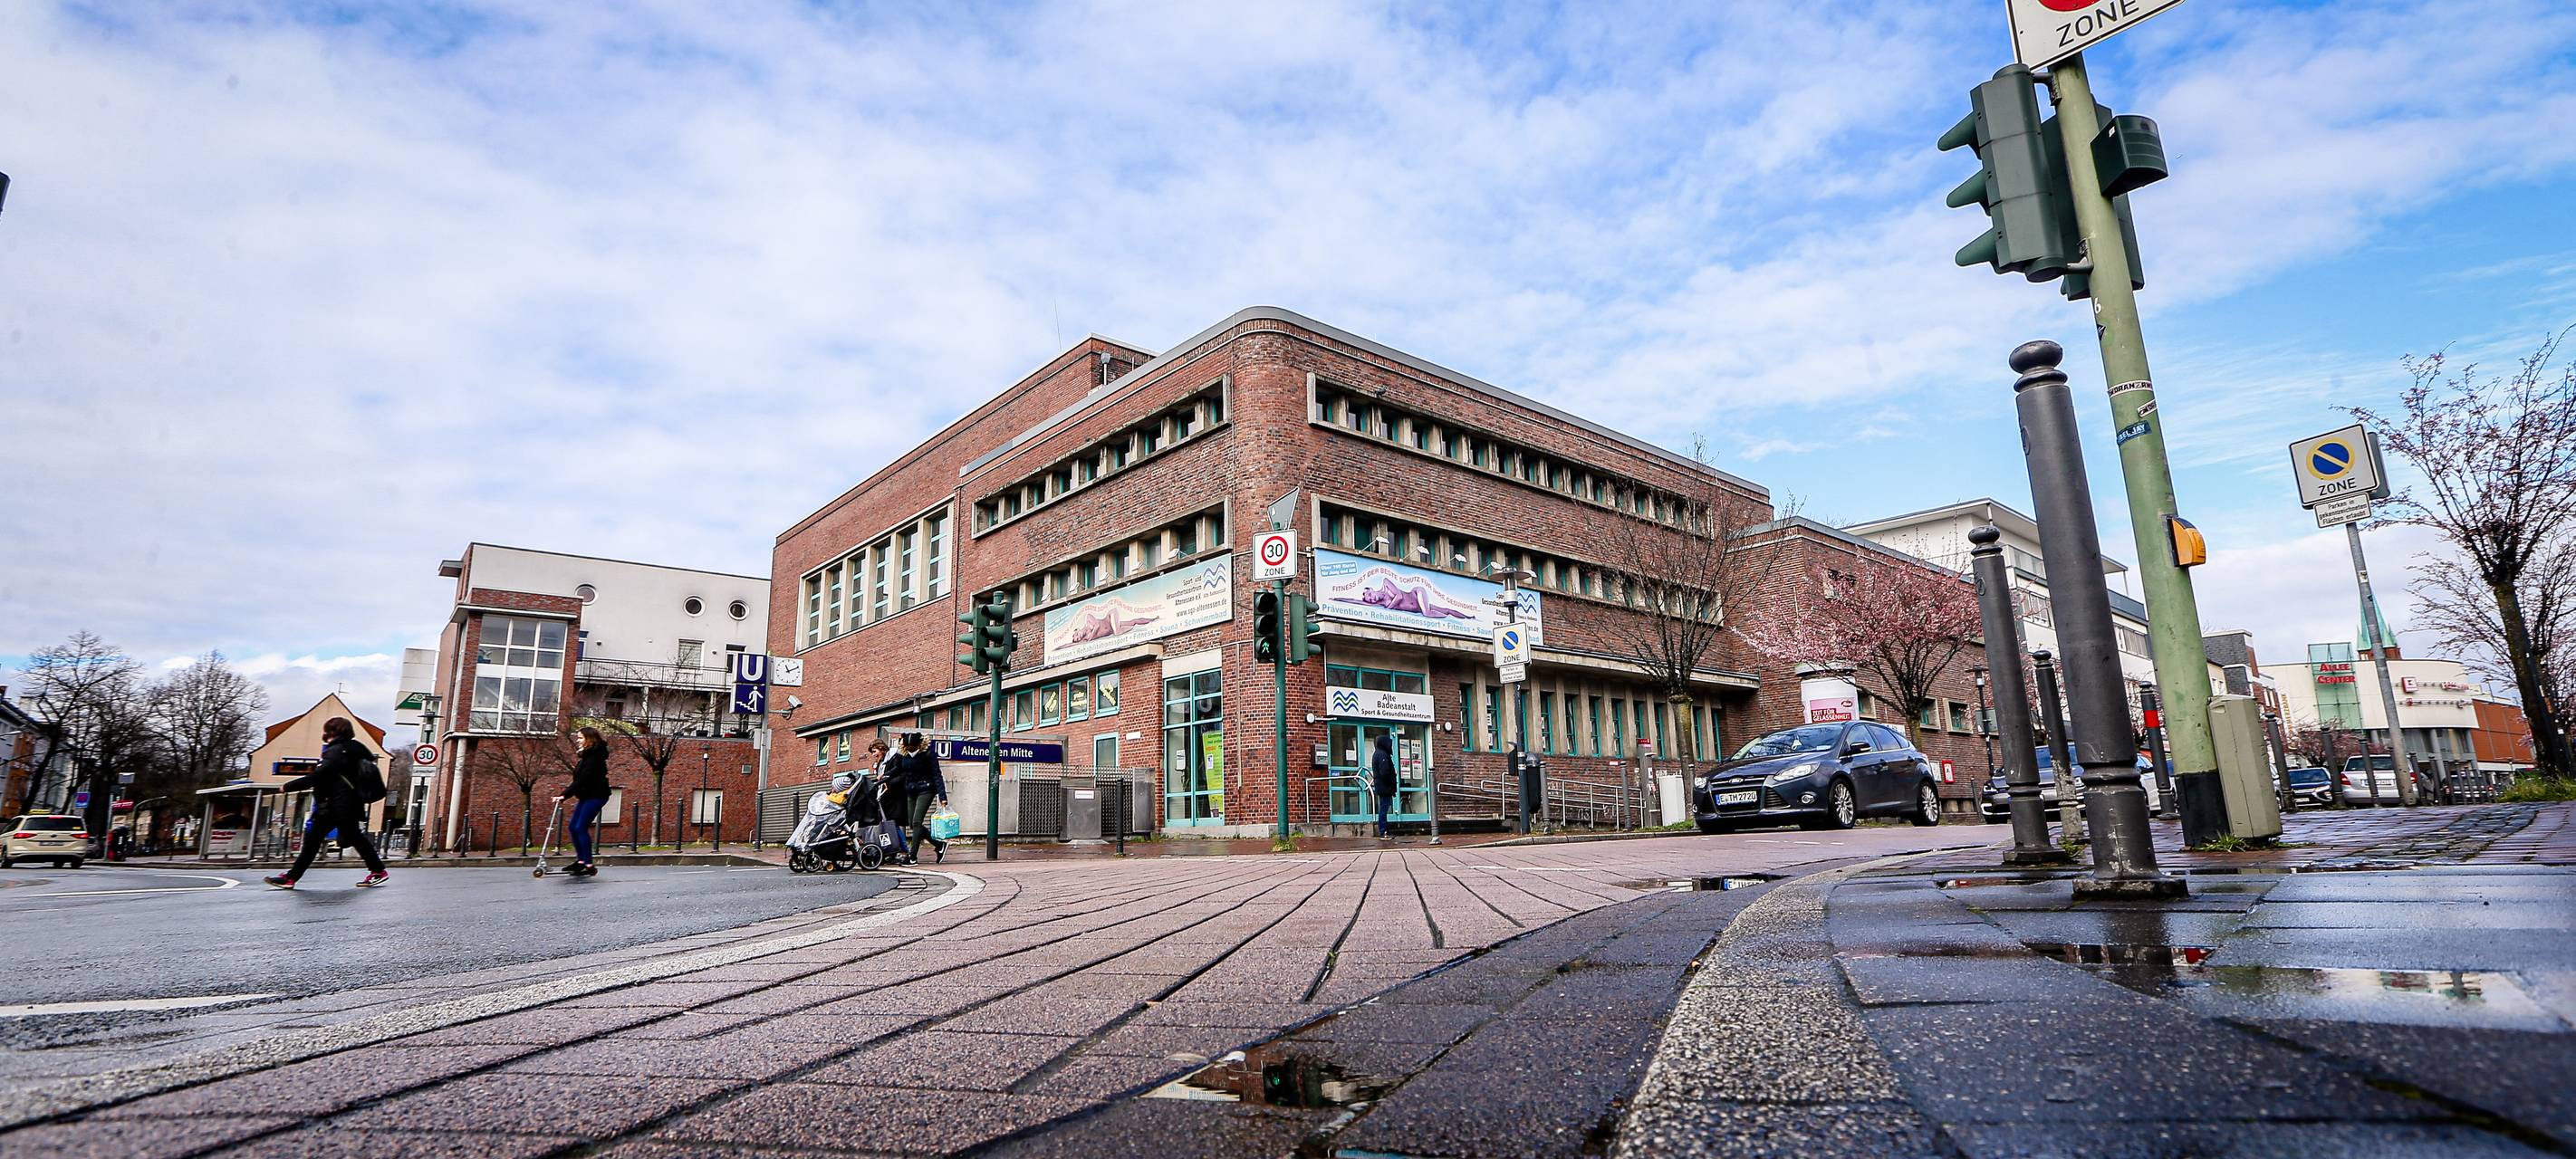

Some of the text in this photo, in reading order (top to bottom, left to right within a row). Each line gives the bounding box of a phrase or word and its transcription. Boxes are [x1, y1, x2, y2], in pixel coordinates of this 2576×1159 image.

[2056, 0, 2139, 48] ZONE
[2094, 297, 2101, 314] 6
[2318, 477, 2357, 496] ZONE
[2319, 503, 2368, 520] gekennzeichneten
[2328, 501, 2347, 510] Parken
[2322, 511, 2366, 524] Flächen erlaubt
[1266, 543, 1283, 558] 30
[1264, 567, 1285, 576] ZONE
[1332, 581, 1357, 592] FITNESS
[1357, 574, 1366, 585] IST
[1368, 568, 1379, 578] DER
[1380, 567, 1399, 581] BESTE
[1322, 603, 1493, 636] Prävention Rehabilitationssport Fitness Saun
[1047, 609, 1226, 662] Prävention Rehabilitationssport Fitness Sauna Schwimmbad
[1504, 654, 1521, 663] ZONE
[741, 655, 764, 681] U
[1377, 701, 1417, 712] Badeanstalt
[1382, 694, 1397, 704] Alte
[1382, 710, 1431, 719] Gesundheitszentrum
[418, 750, 433, 760] 30
[938, 742, 1033, 757] U Alteneen Mitte
